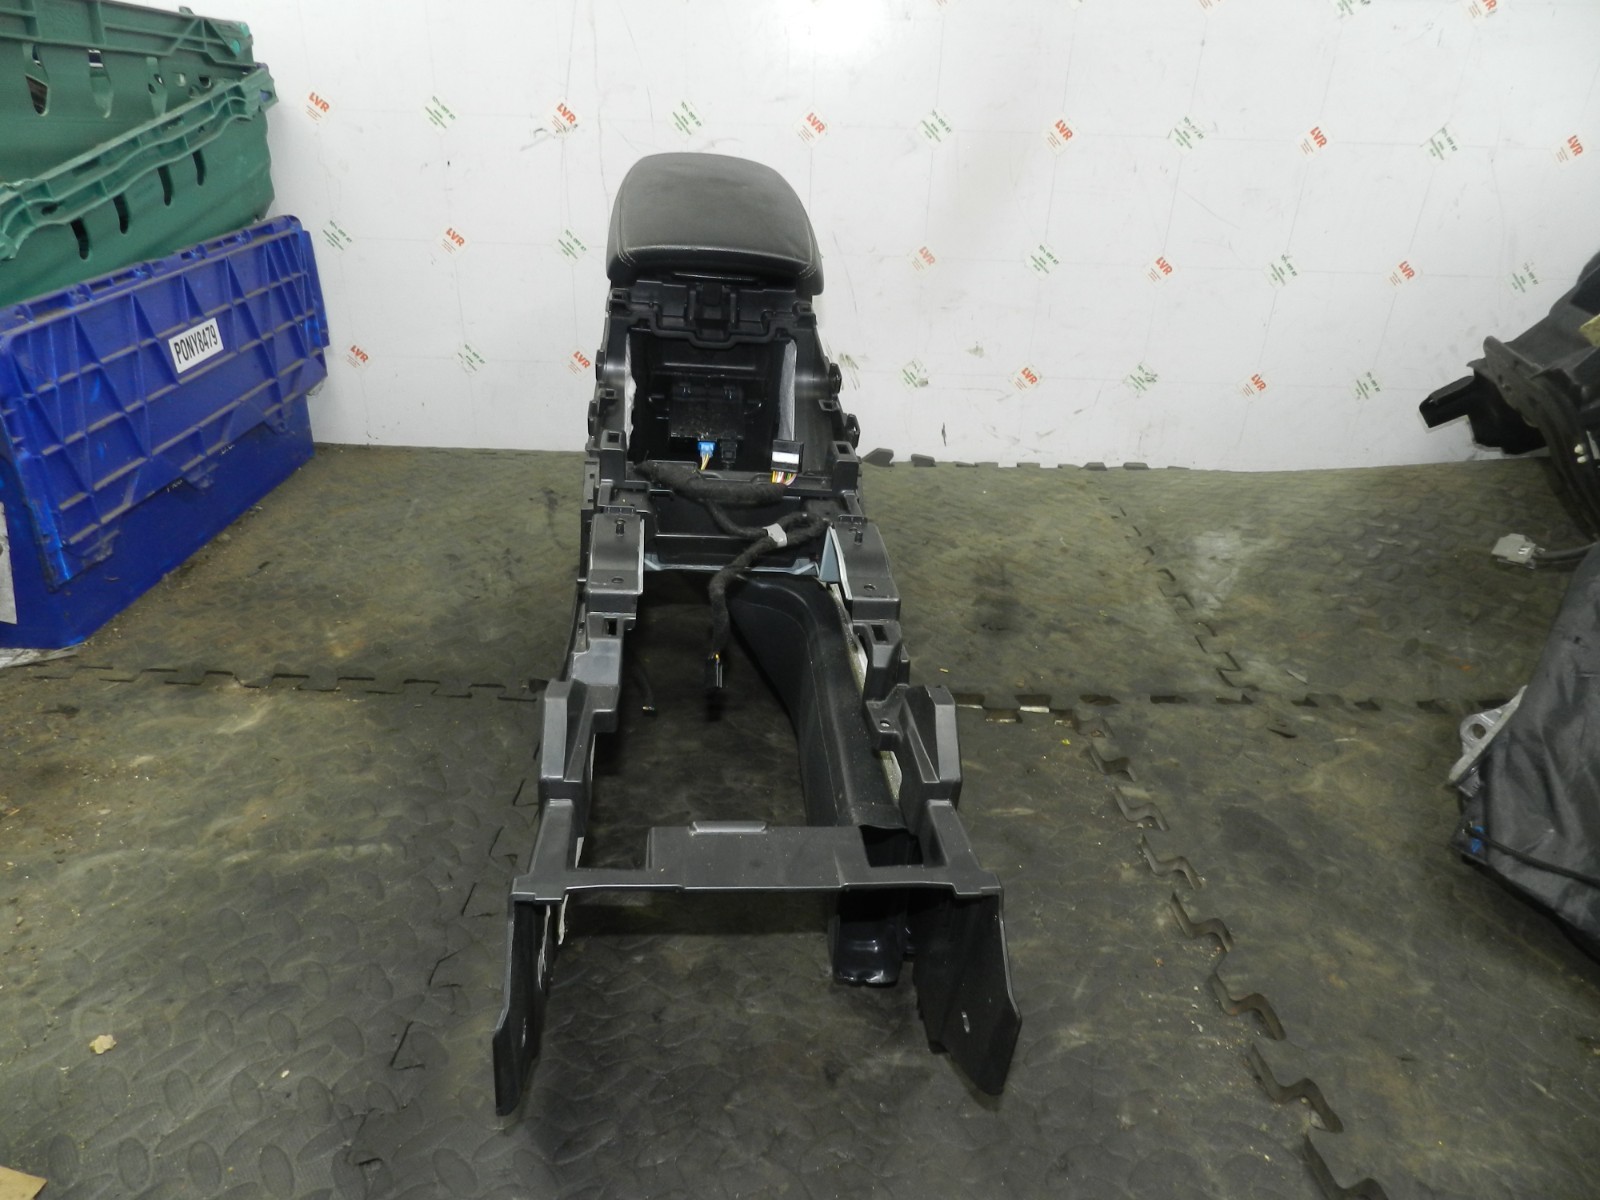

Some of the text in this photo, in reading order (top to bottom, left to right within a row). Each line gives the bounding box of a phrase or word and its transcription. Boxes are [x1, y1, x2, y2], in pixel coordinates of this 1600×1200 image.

[309, 92, 329, 112] LVR
[556, 103, 576, 124] LVR
[806, 112, 825, 133] LVR
[1055, 119, 1073, 140] LVR
[1310, 126, 1327, 148] LVR
[1567, 135, 1583, 156] LVR
[446, 228, 465, 247] LVR
[1156, 256, 1172, 275] LVR
[1399, 261, 1415, 279] LVR
[174, 324, 218, 364] PONY8479
[351, 345, 368, 363] LVR
[573, 351, 590, 368] LVR
[1021, 367, 1038, 384] LVR
[1251, 373, 1266, 391] LVR
